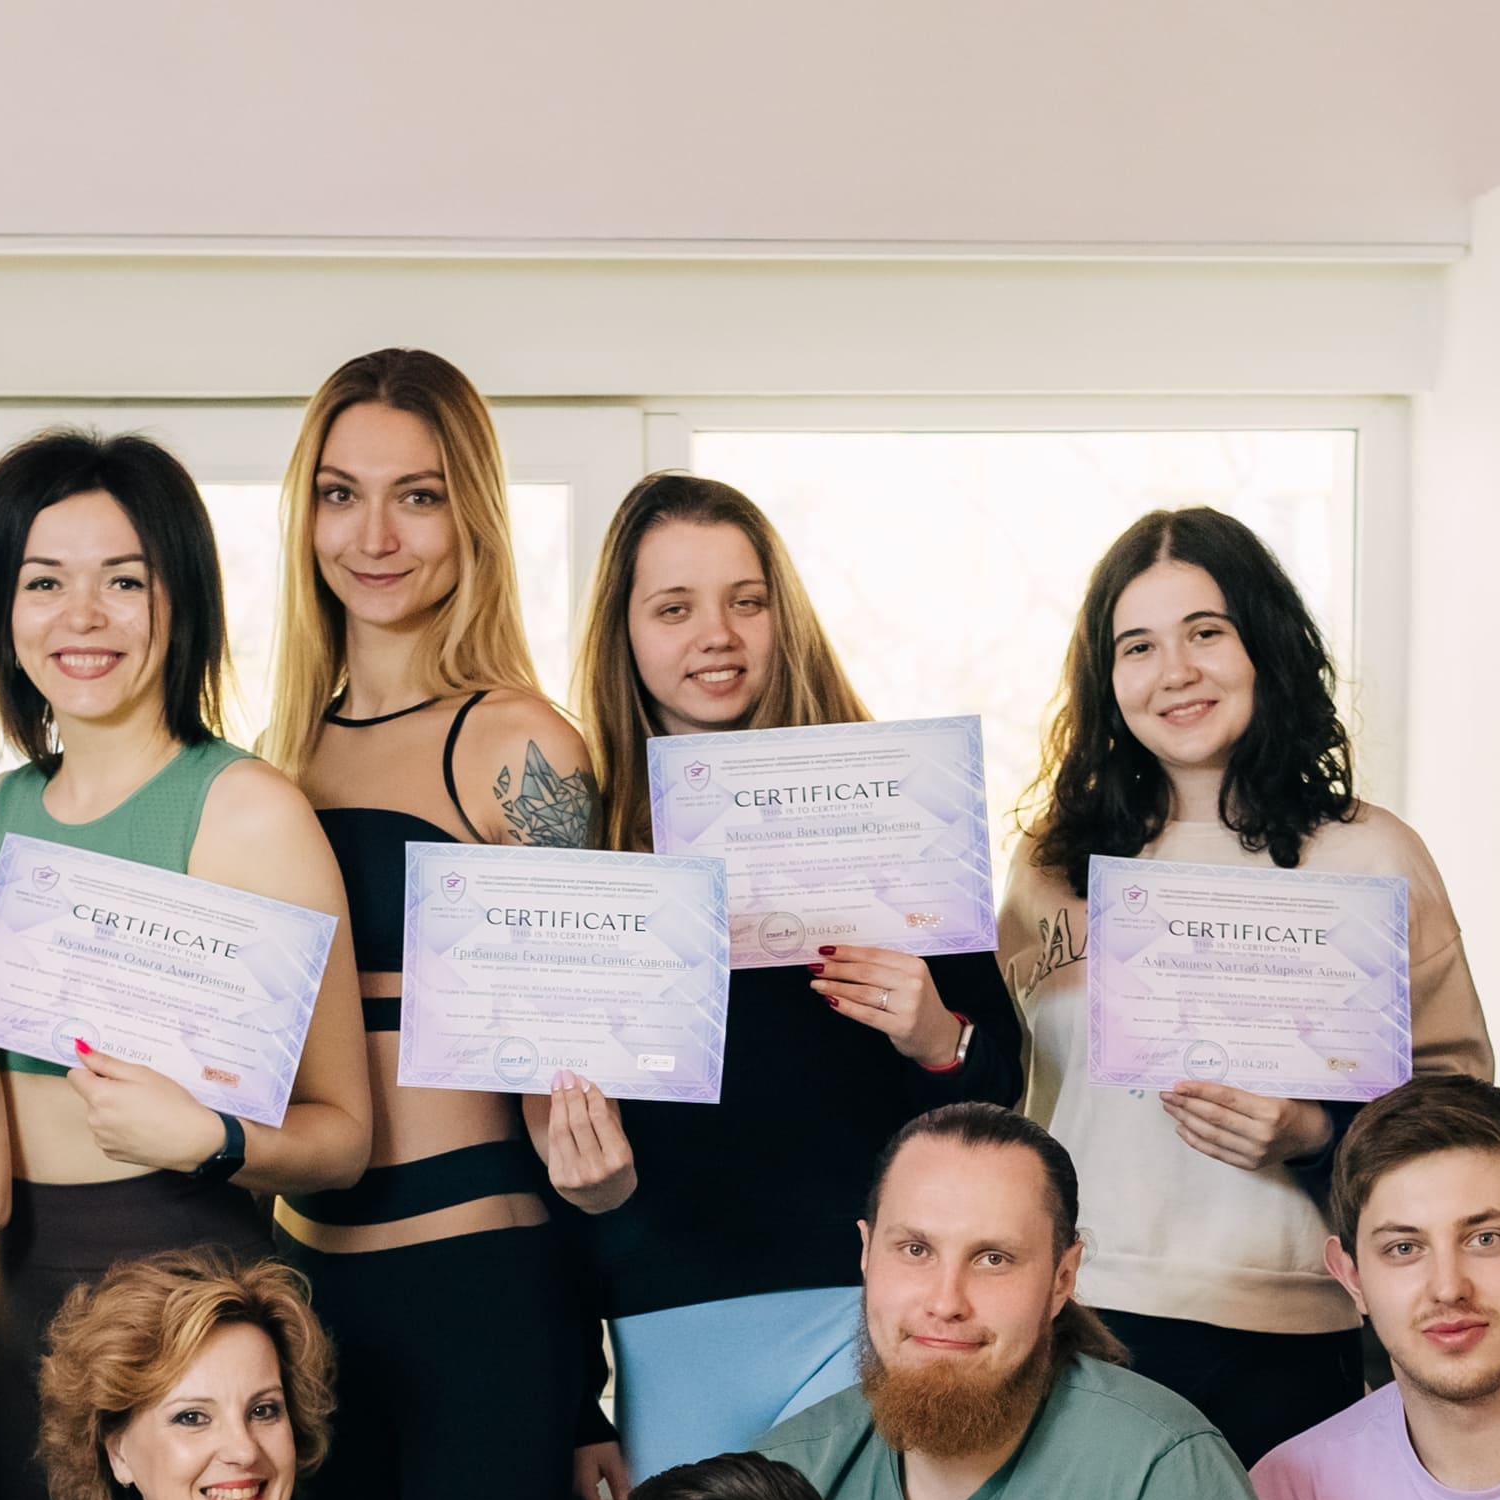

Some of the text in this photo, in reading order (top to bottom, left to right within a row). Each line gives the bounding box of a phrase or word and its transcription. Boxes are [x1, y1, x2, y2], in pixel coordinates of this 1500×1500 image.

[733, 778, 901, 809] CERTIFICATE
[797, 806, 809, 814] TO
[810, 803, 847, 813] CERTIFY
[851, 801, 874, 810] THAT
[725, 817, 921, 843] Мосолова Виктория Юрьевна
[70, 901, 240, 960] CERTIFICATE
[485, 906, 647, 933] CERTIFICATE
[805, 923, 858, 936] 13.04.2024
[1167, 917, 1327, 946] CERTIFICATE
[512, 928, 619, 942] THIS IS TO CERTIFY THAT
[56, 933, 247, 996] Кузьмина Ольга Дмитриевна
[451, 945, 687, 970] Грибанова Екатерина Станиславовна
[539, 1055, 588, 1068] 13.04.2024
[1229, 1058, 1279, 1070] 13.04.2024
